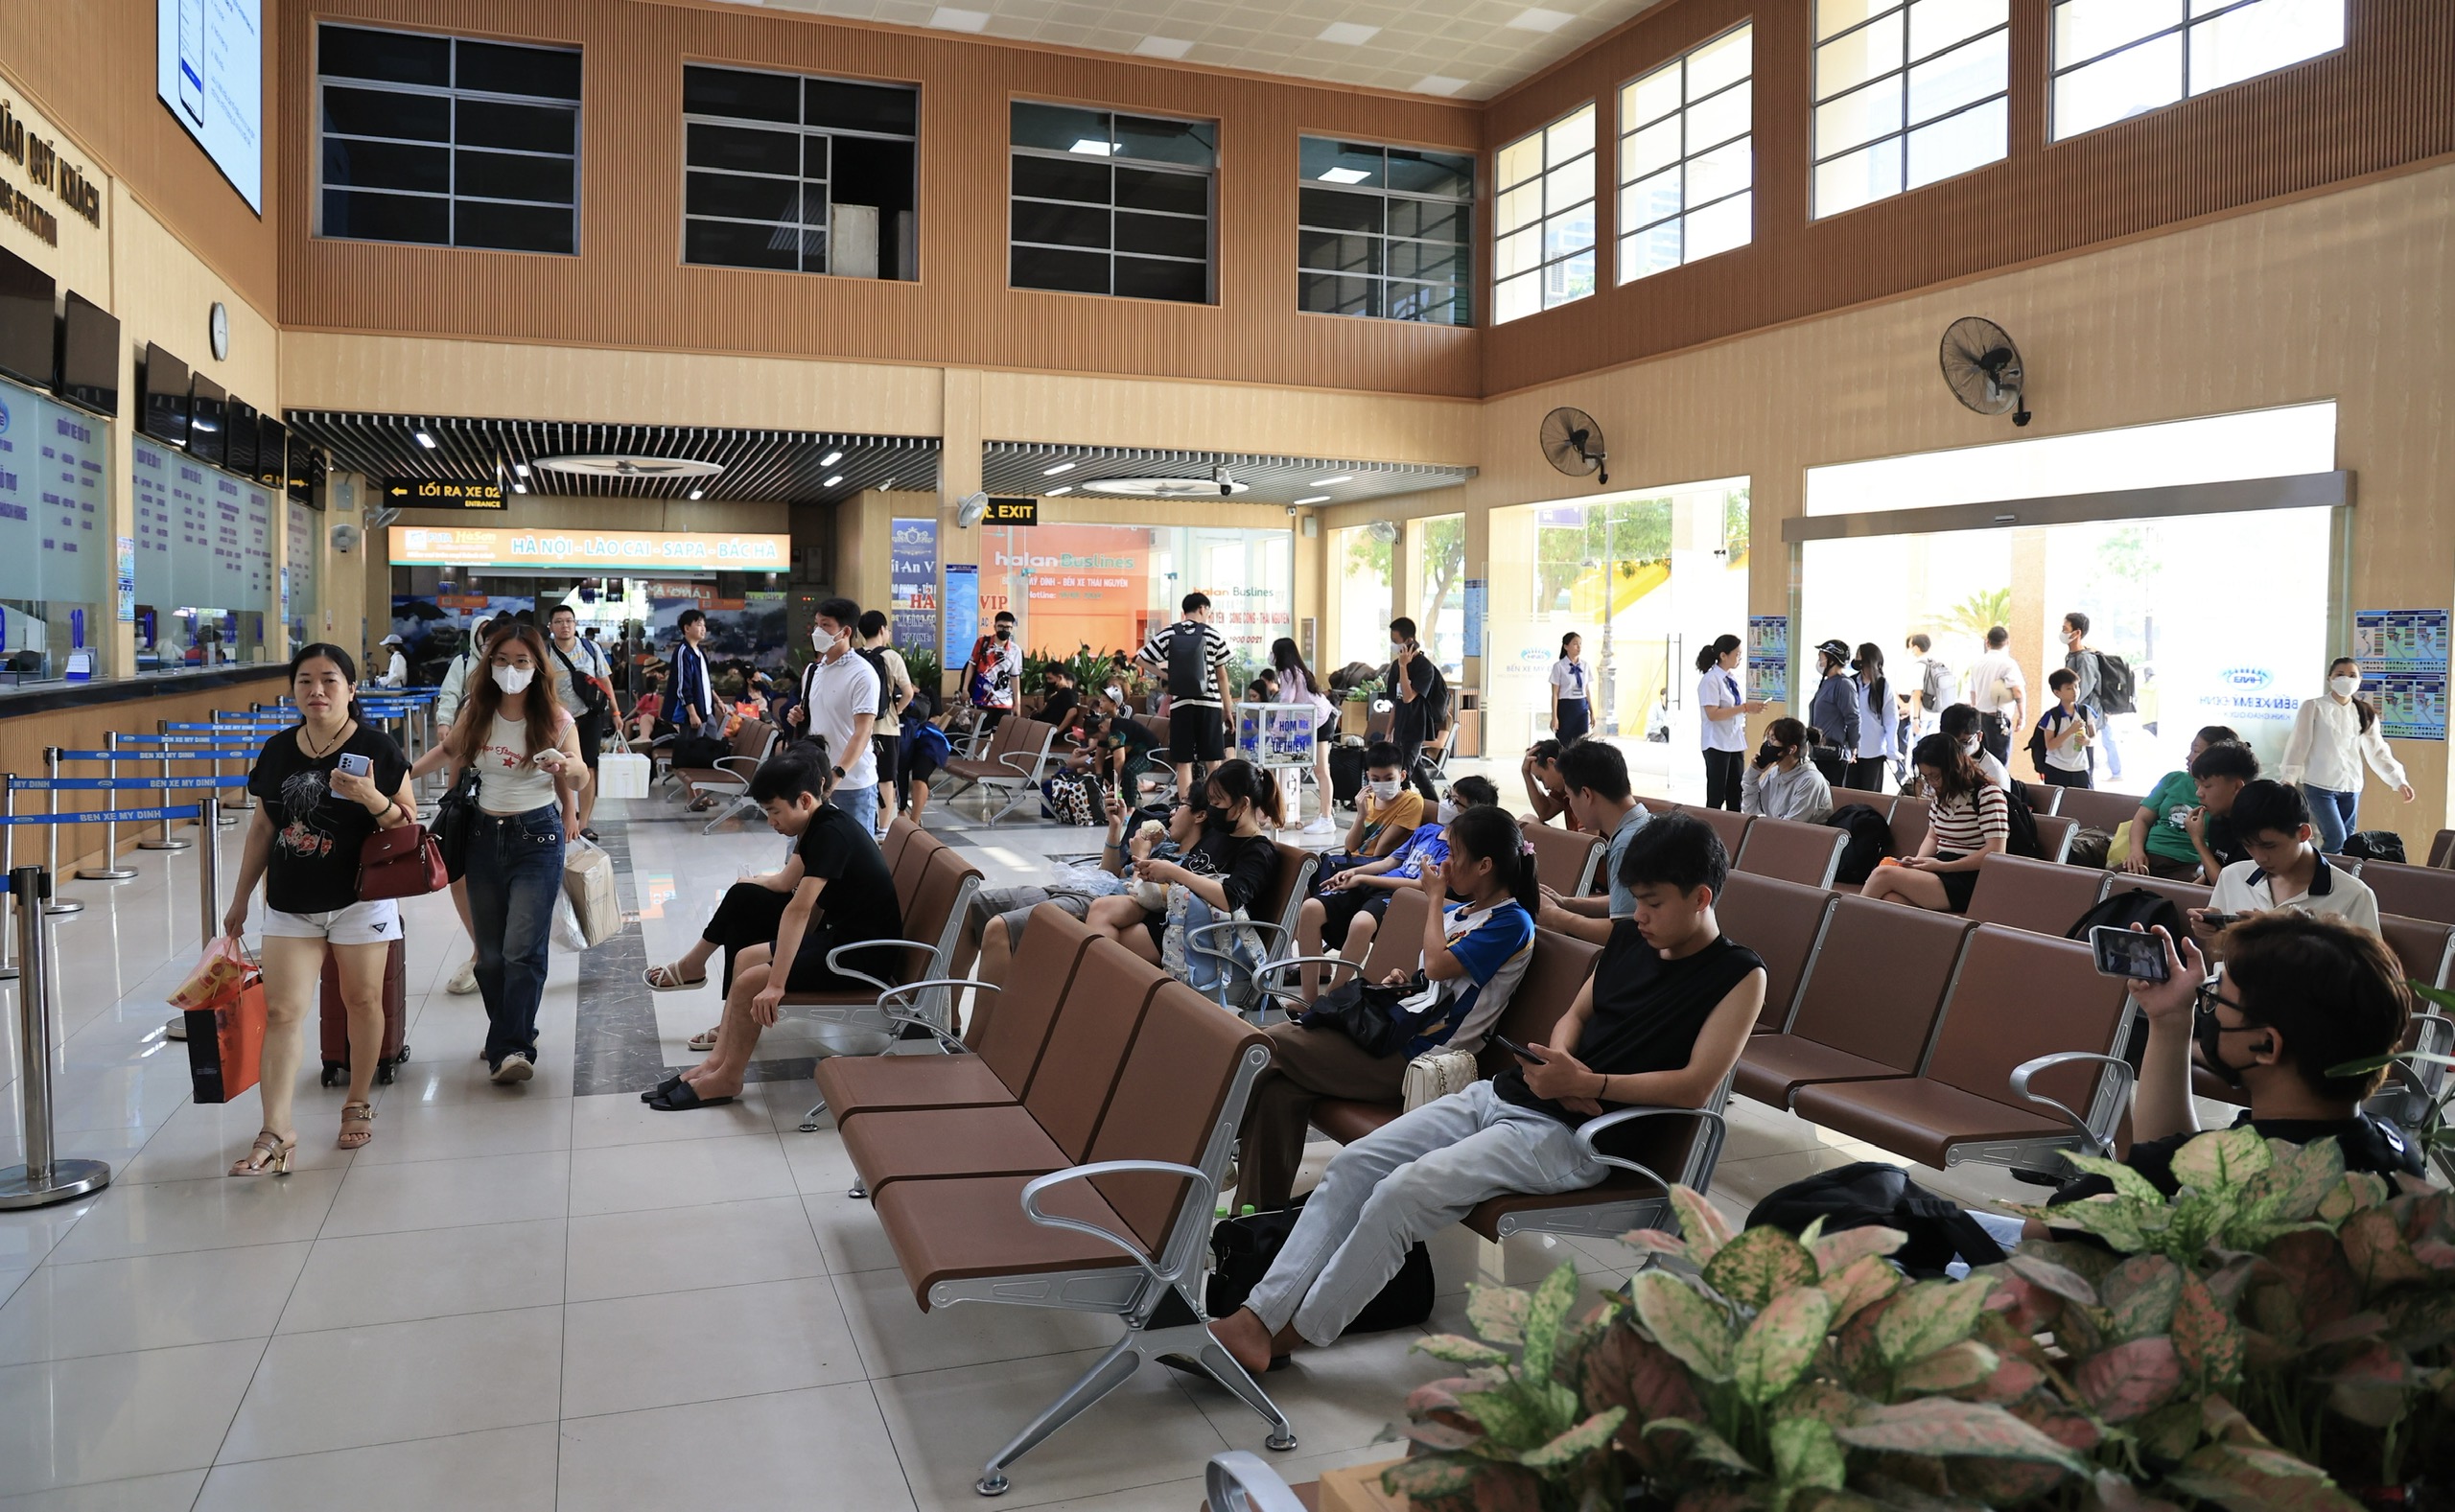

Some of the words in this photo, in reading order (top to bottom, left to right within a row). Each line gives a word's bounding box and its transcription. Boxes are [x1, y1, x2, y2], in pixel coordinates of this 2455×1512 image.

[419, 481, 440, 496] LỐI
[444, 485, 462, 497] RA
[465, 486, 482, 498] XE
[484, 486, 502, 499] 02
[465, 500, 501, 508] ENTRANCE
[998, 505, 1034, 518] EXIT
[512, 535, 537, 555] HÀ
[541, 536, 573, 559] NỘI
[584, 537, 619, 556] LÀO
[623, 540, 652, 557] CAI
[663, 541, 707, 559] SAPA
[754, 540, 779, 559] HÀ
[900, 560, 921, 572] An
[994, 551, 1059, 567] halan
[1061, 553, 1134, 568] Buslines
[1233, 586, 1274, 597] Buslines
[979, 594, 1007, 610] VIP
[70, 608, 84, 648] 10
[150, 779, 166, 788] BEN
[80, 813, 101, 822] BEN
[103, 812, 117, 821] XE
[119, 811, 134, 820] MY
[136, 809, 161, 819] DINH
